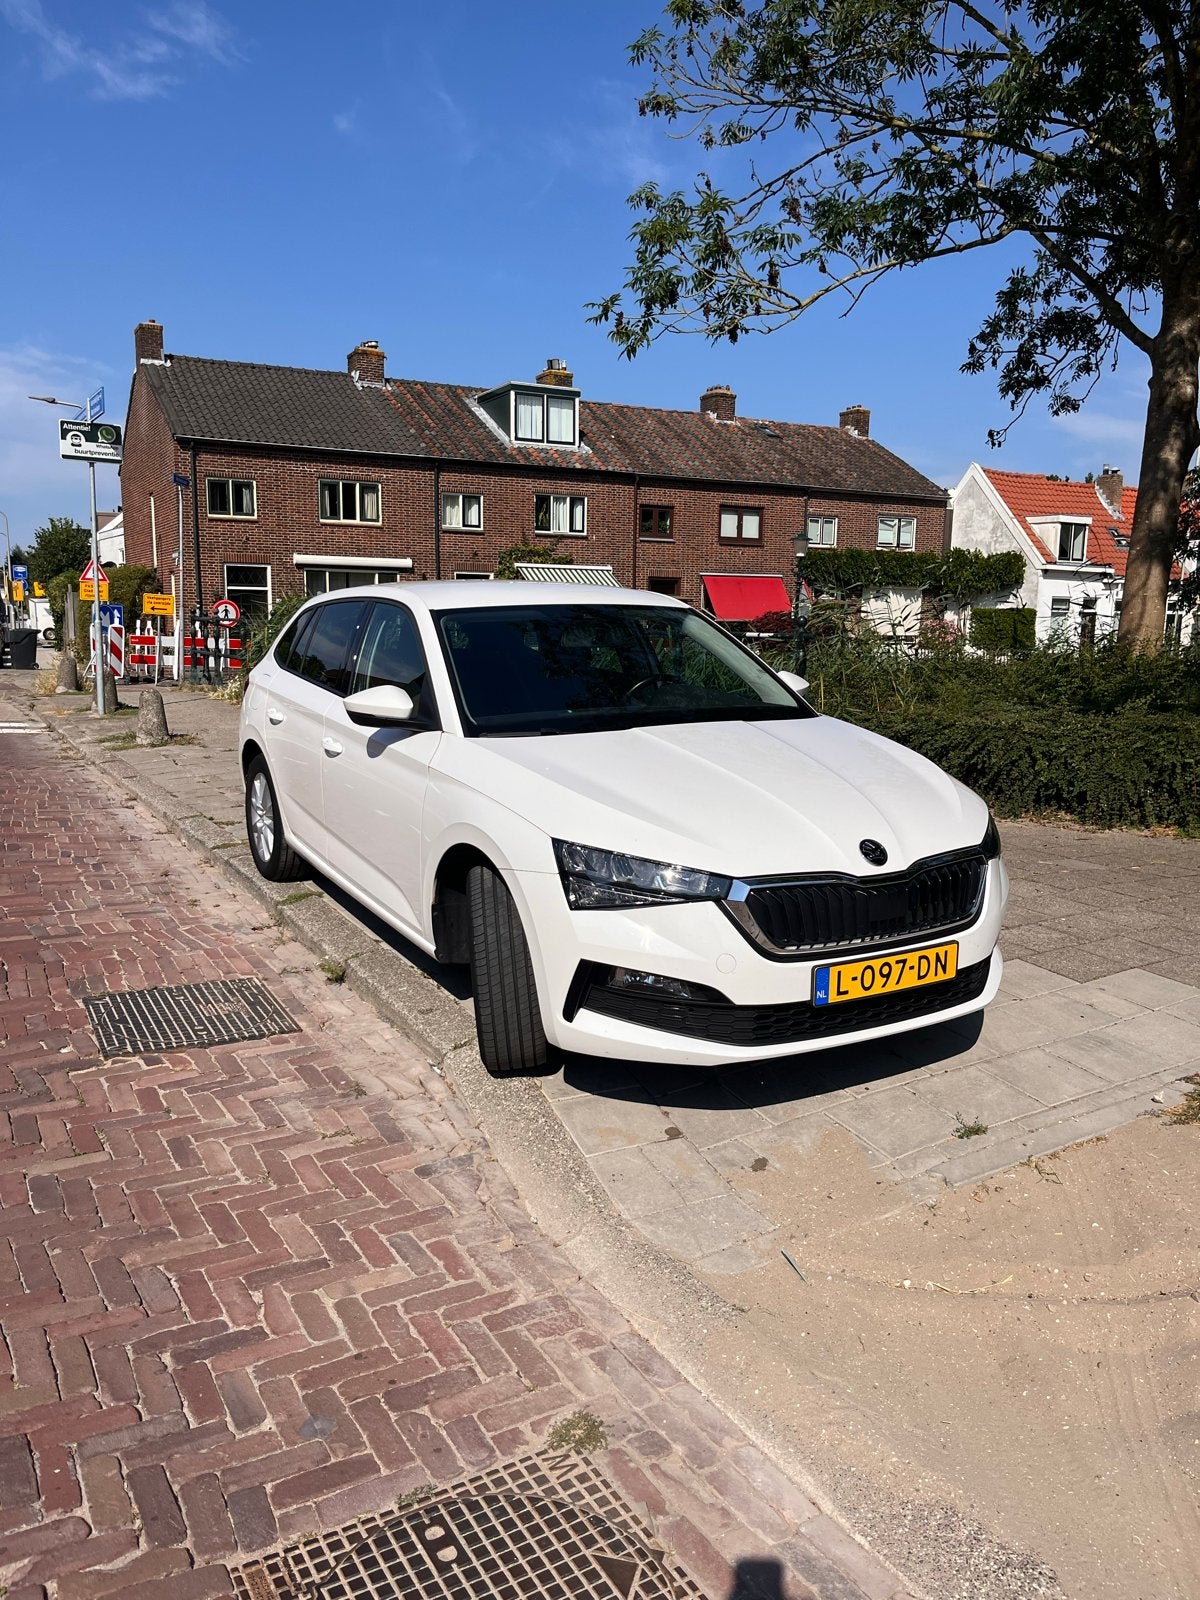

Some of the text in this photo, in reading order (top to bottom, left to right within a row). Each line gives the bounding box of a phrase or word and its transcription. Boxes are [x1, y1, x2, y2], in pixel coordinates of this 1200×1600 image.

[63, 423, 91, 432] Attentie!
[74, 448, 120, 458] buurtpreventie
[816, 950, 948, 999] NL L-097-DN
